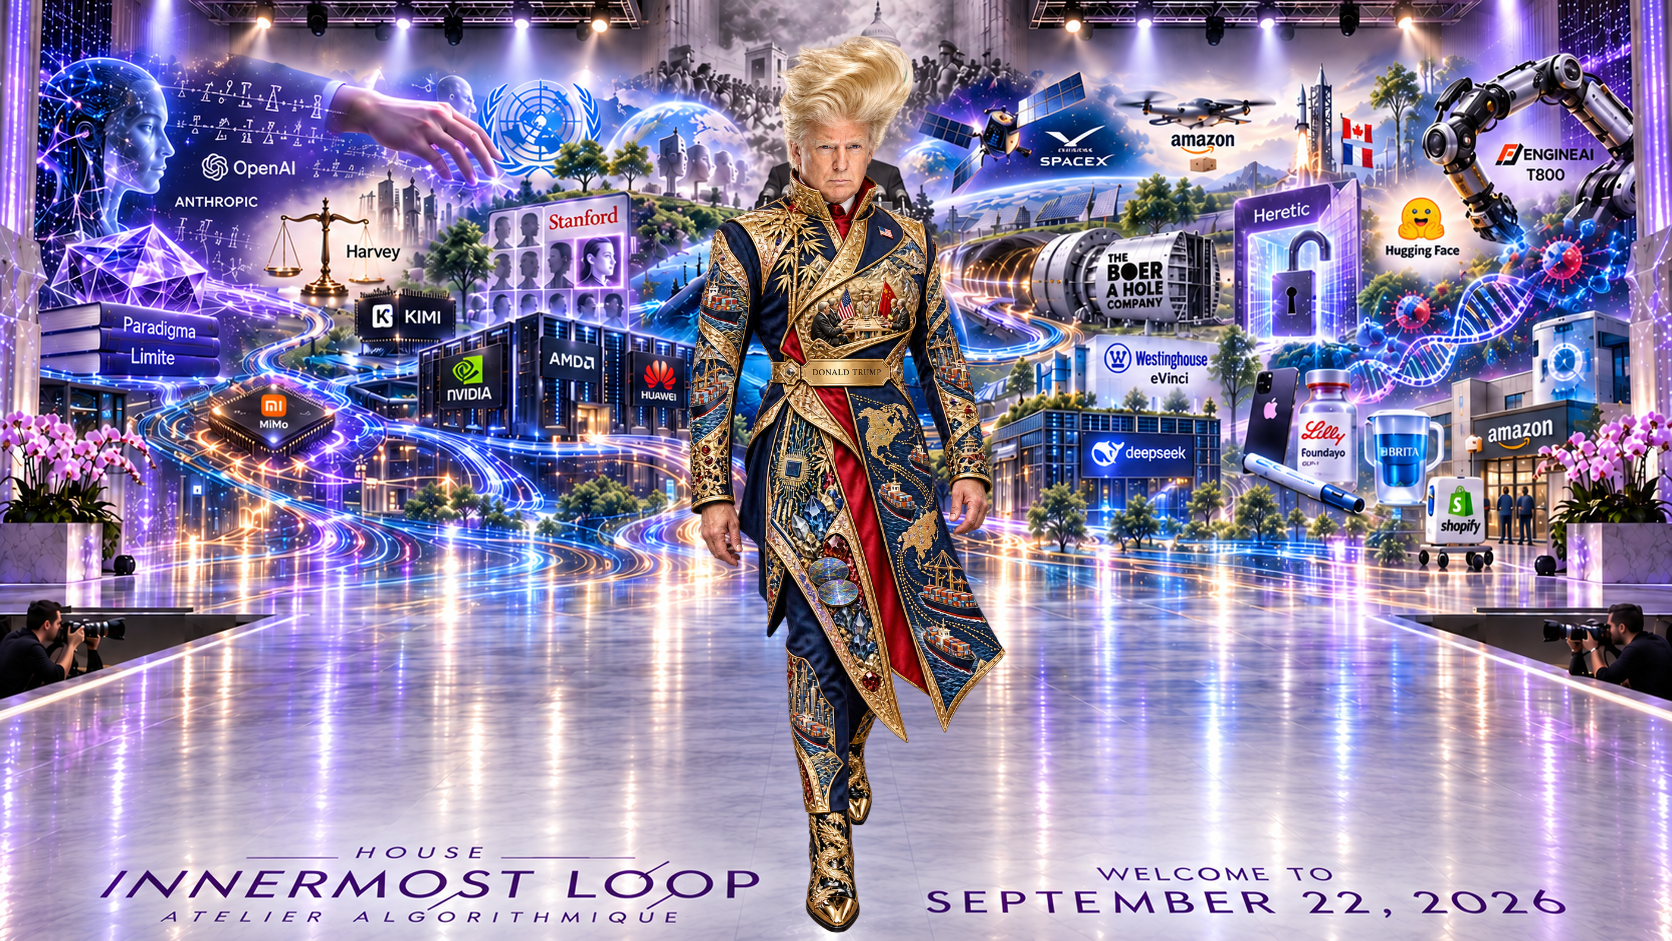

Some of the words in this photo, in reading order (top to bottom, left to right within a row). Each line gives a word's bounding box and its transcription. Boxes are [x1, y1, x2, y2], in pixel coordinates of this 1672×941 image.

[1171, 134, 1235, 147] amazon
[1040, 154, 1115, 167] SPACEX
[1523, 148, 1594, 161] ENGINEAI
[233, 160, 296, 179] OpenAI
[1526, 168, 1565, 181] T800
[175, 196, 258, 208] ANTHROPIC
[549, 205, 618, 230] Stanford
[1254, 202, 1310, 223] Heretic
[346, 244, 400, 262] Harvey
[1108, 253, 1128, 263] THE
[1385, 244, 1432, 259] Hugging
[1434, 245, 1460, 256] Face
[1106, 283, 1118, 298] A
[1123, 280, 1163, 297] HOLE
[1107, 297, 1163, 310] COMPANY
[405, 309, 441, 324] KIMI
[123, 316, 196, 340] Paradigma
[131, 347, 175, 365] Limite
[550, 352, 585, 369] AMD
[1135, 350, 1208, 370] Westinghouse
[812, 368, 850, 376] DONALD
[852, 368, 882, 376] TRUMP
[1150, 372, 1189, 384] eVinci
[641, 390, 677, 402] HUAWEI
[259, 420, 289, 429] MiMo
[1487, 419, 1553, 443] amazon
[1301, 420, 1346, 446] Lilly
[1125, 446, 1187, 462] deepseek
[1301, 448, 1346, 460] Foundayo
[1388, 446, 1420, 457] BRITA
[1440, 519, 1481, 535] shopify
